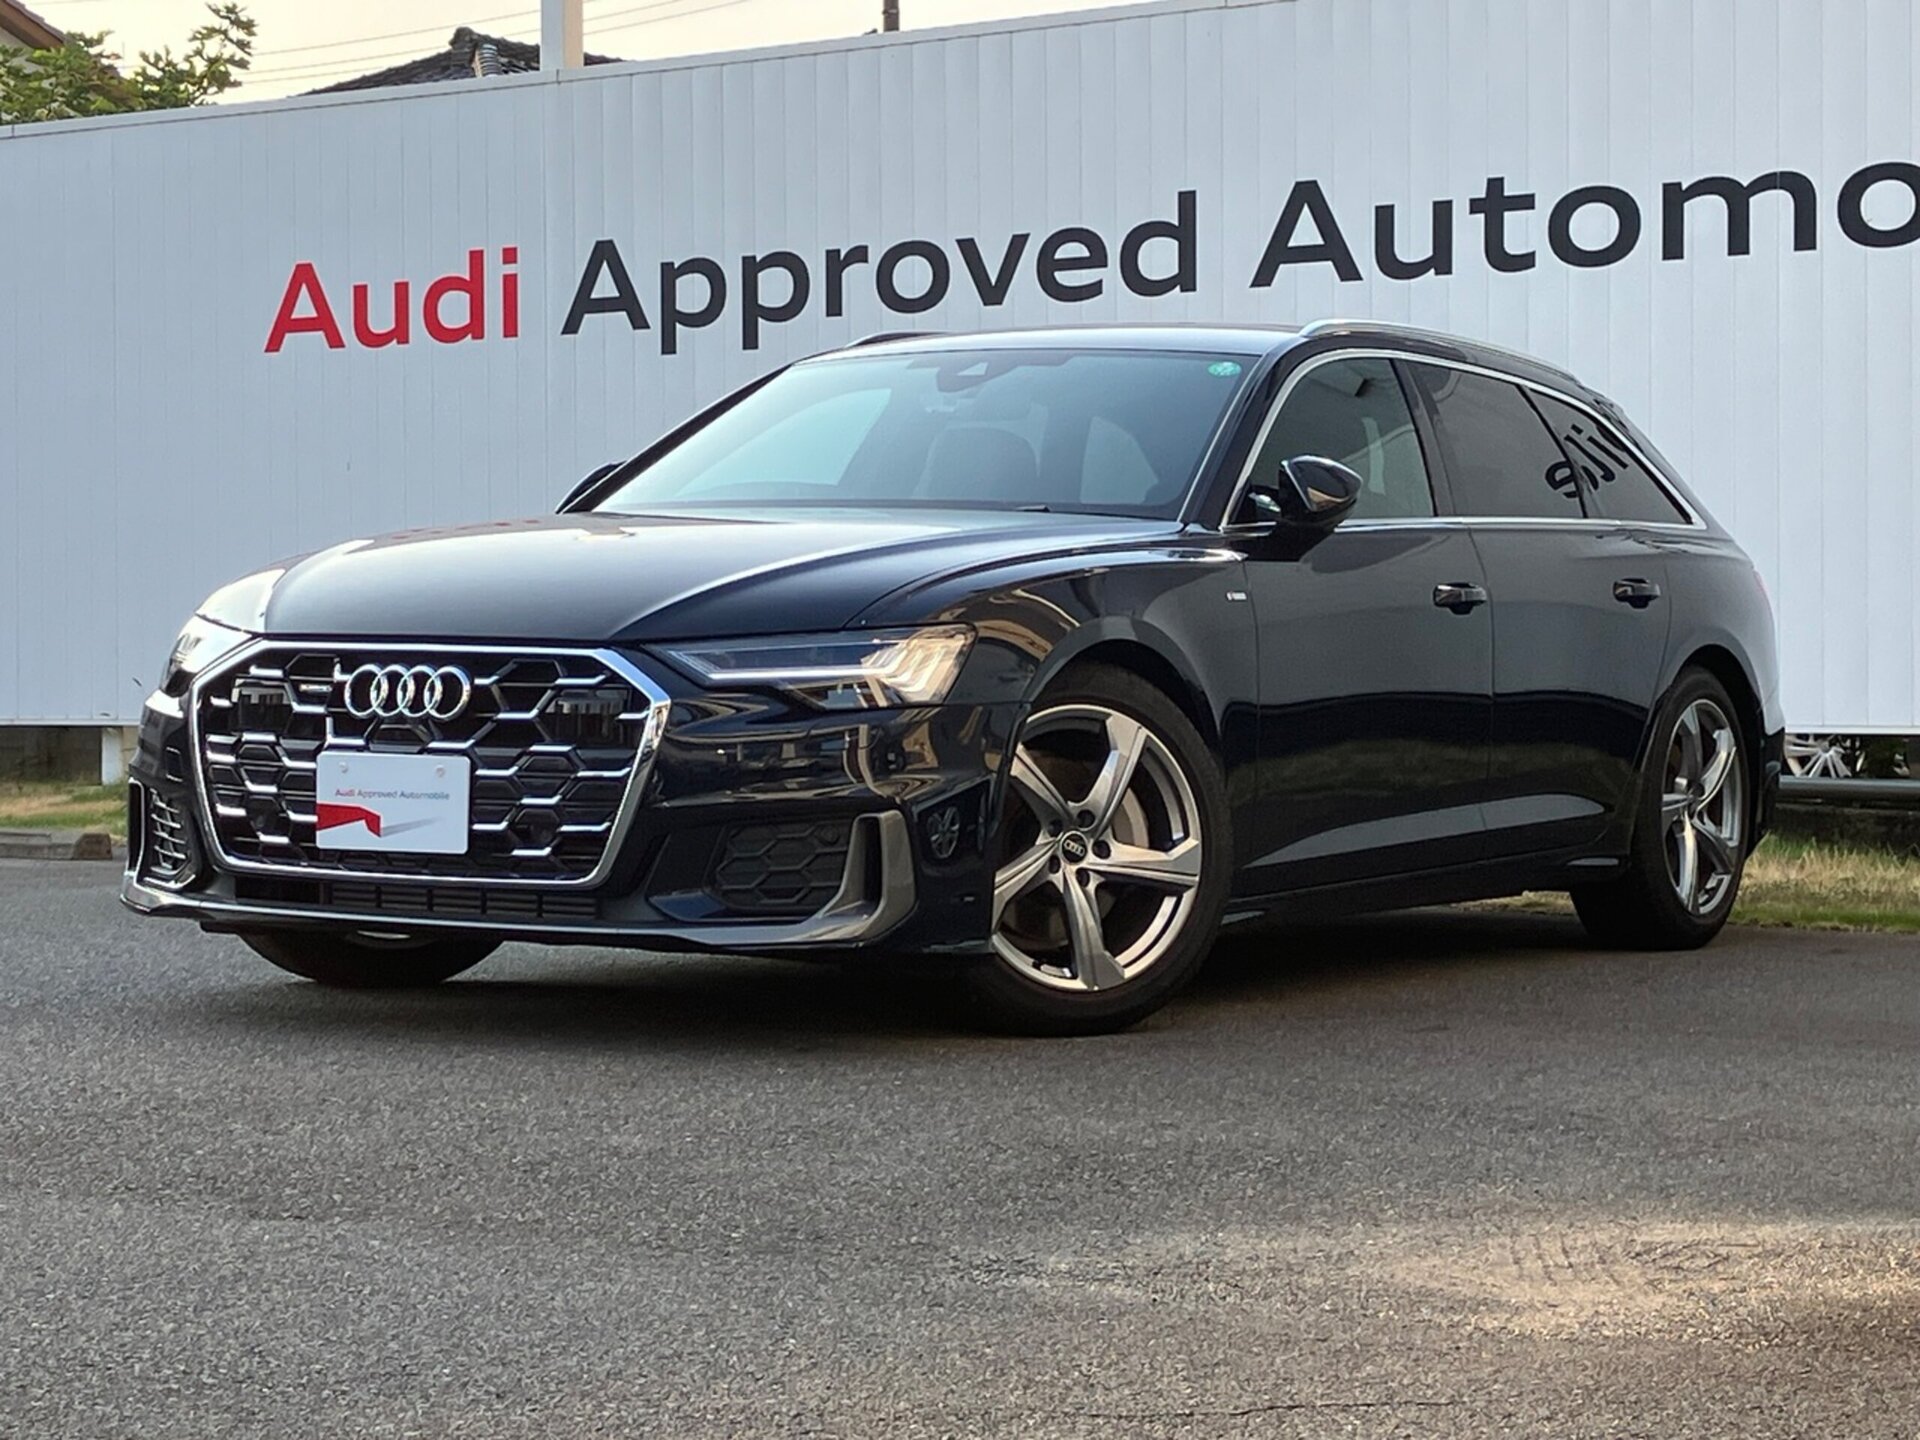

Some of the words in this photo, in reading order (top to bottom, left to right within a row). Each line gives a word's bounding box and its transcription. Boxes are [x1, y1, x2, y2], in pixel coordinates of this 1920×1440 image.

[265, 246, 519, 353] Audi
[561, 189, 1197, 356] Approved
[1250, 162, 1920, 289] Automo
[335, 788, 355, 797] Audi
[357, 789, 398, 799] Approved
[399, 790, 450, 800] Automobile
